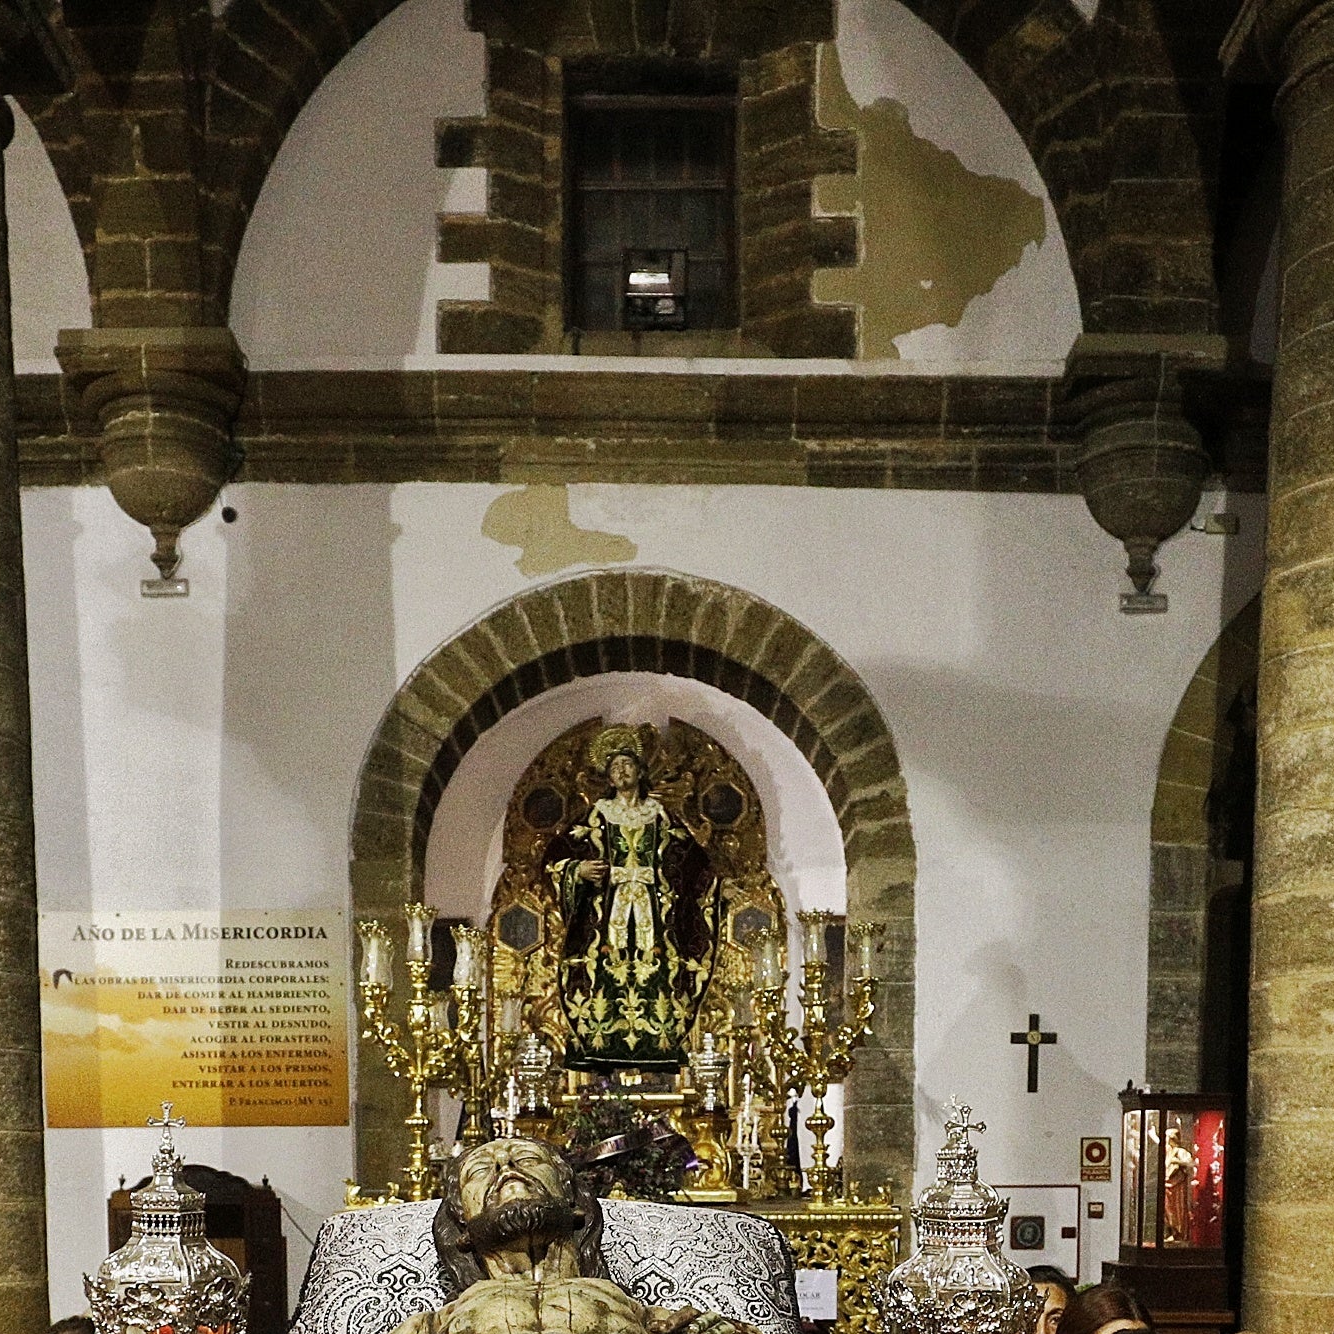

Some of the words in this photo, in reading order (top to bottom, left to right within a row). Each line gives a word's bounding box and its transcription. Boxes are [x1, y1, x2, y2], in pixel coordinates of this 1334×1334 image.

[72, 924, 115, 941] AÑO
[121, 928, 146, 941] DE
[152, 927, 176, 941] LA
[182, 923, 328, 941] MISERICORDIA
[225, 958, 330, 969] REDESCUBRAMOS
[75, 976, 96, 985] LAS
[98, 976, 137, 985] OBRAS
[140, 976, 155, 985] DE
[159, 975, 245, 985] MISERICORDIA
[137, 991, 162, 999] DAR
[165, 991, 182, 999] DE
[228, 990, 244, 999] AL
[163, 1006, 187, 1014] DAR
[191, 1006, 205, 1014] DE
[209, 1005, 247, 1014] BEBER
[251, 1005, 266, 1014] AL
[208, 1020, 249, 1029] VESTIR
[253, 1020, 268, 1029] AL
[190, 1035, 238, 1044] ACOGER
[240, 1035, 256, 1044] AL
[181, 1050, 226, 1059] ASISTIR
[230, 1050, 237, 1058] A
[241, 1050, 263, 1058] LOS
[199, 1065, 245, 1073] VISITAR
[250, 1065, 257, 1073] A
[260, 1065, 282, 1073] LOS
[172, 1080, 234, 1088] ENTERRAR
[237, 1080, 245, 1088] A
[249, 1079, 270, 1088] LOS
